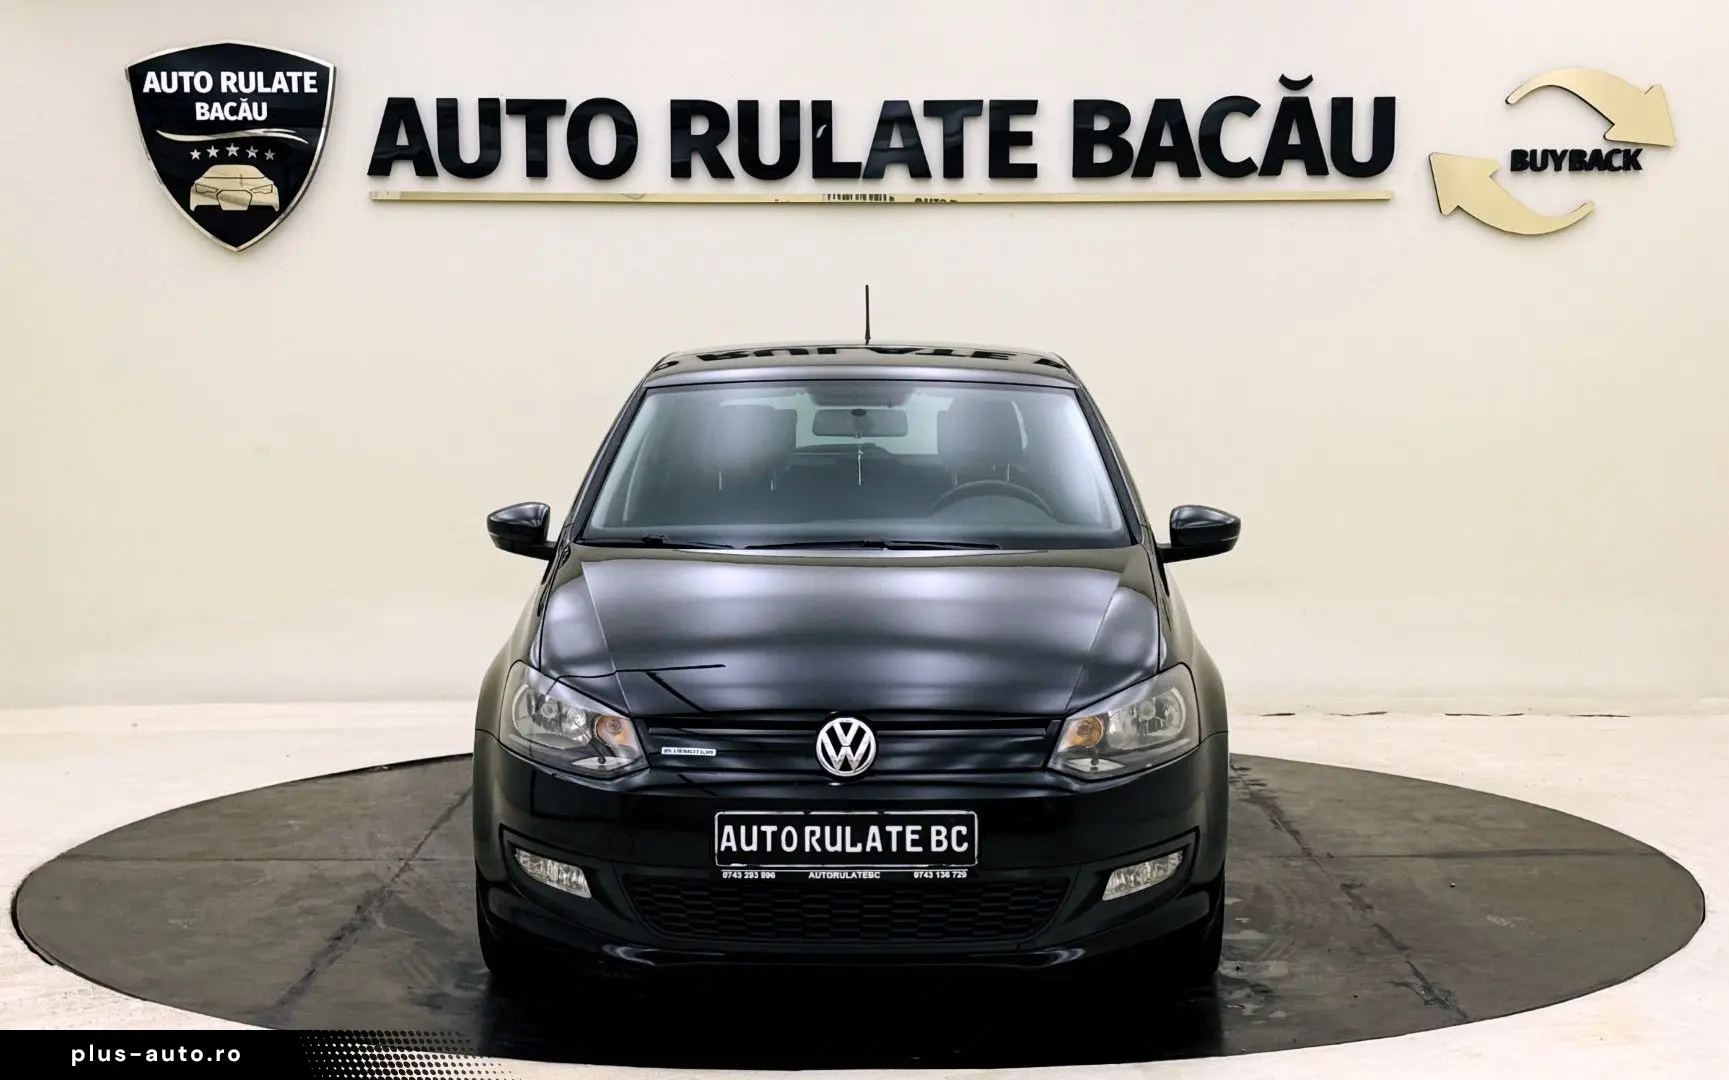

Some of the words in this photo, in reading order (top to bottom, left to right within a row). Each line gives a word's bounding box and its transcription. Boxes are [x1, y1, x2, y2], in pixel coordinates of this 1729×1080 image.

[142, 70, 214, 94] AUTO
[220, 71, 318, 94] RULATE
[195, 97, 268, 121] BACĂU
[366, 96, 640, 182] AUTO
[670, 98, 1040, 182] RULATE
[1071, 73, 1397, 181] BACĂU
[1509, 148, 1644, 173] BUYBACK
[930, 825, 970, 853] BC
[722, 871, 742, 879] 0743
[808, 871, 881, 879] AUTORULATEBC
[913, 871, 933, 879] 0743
